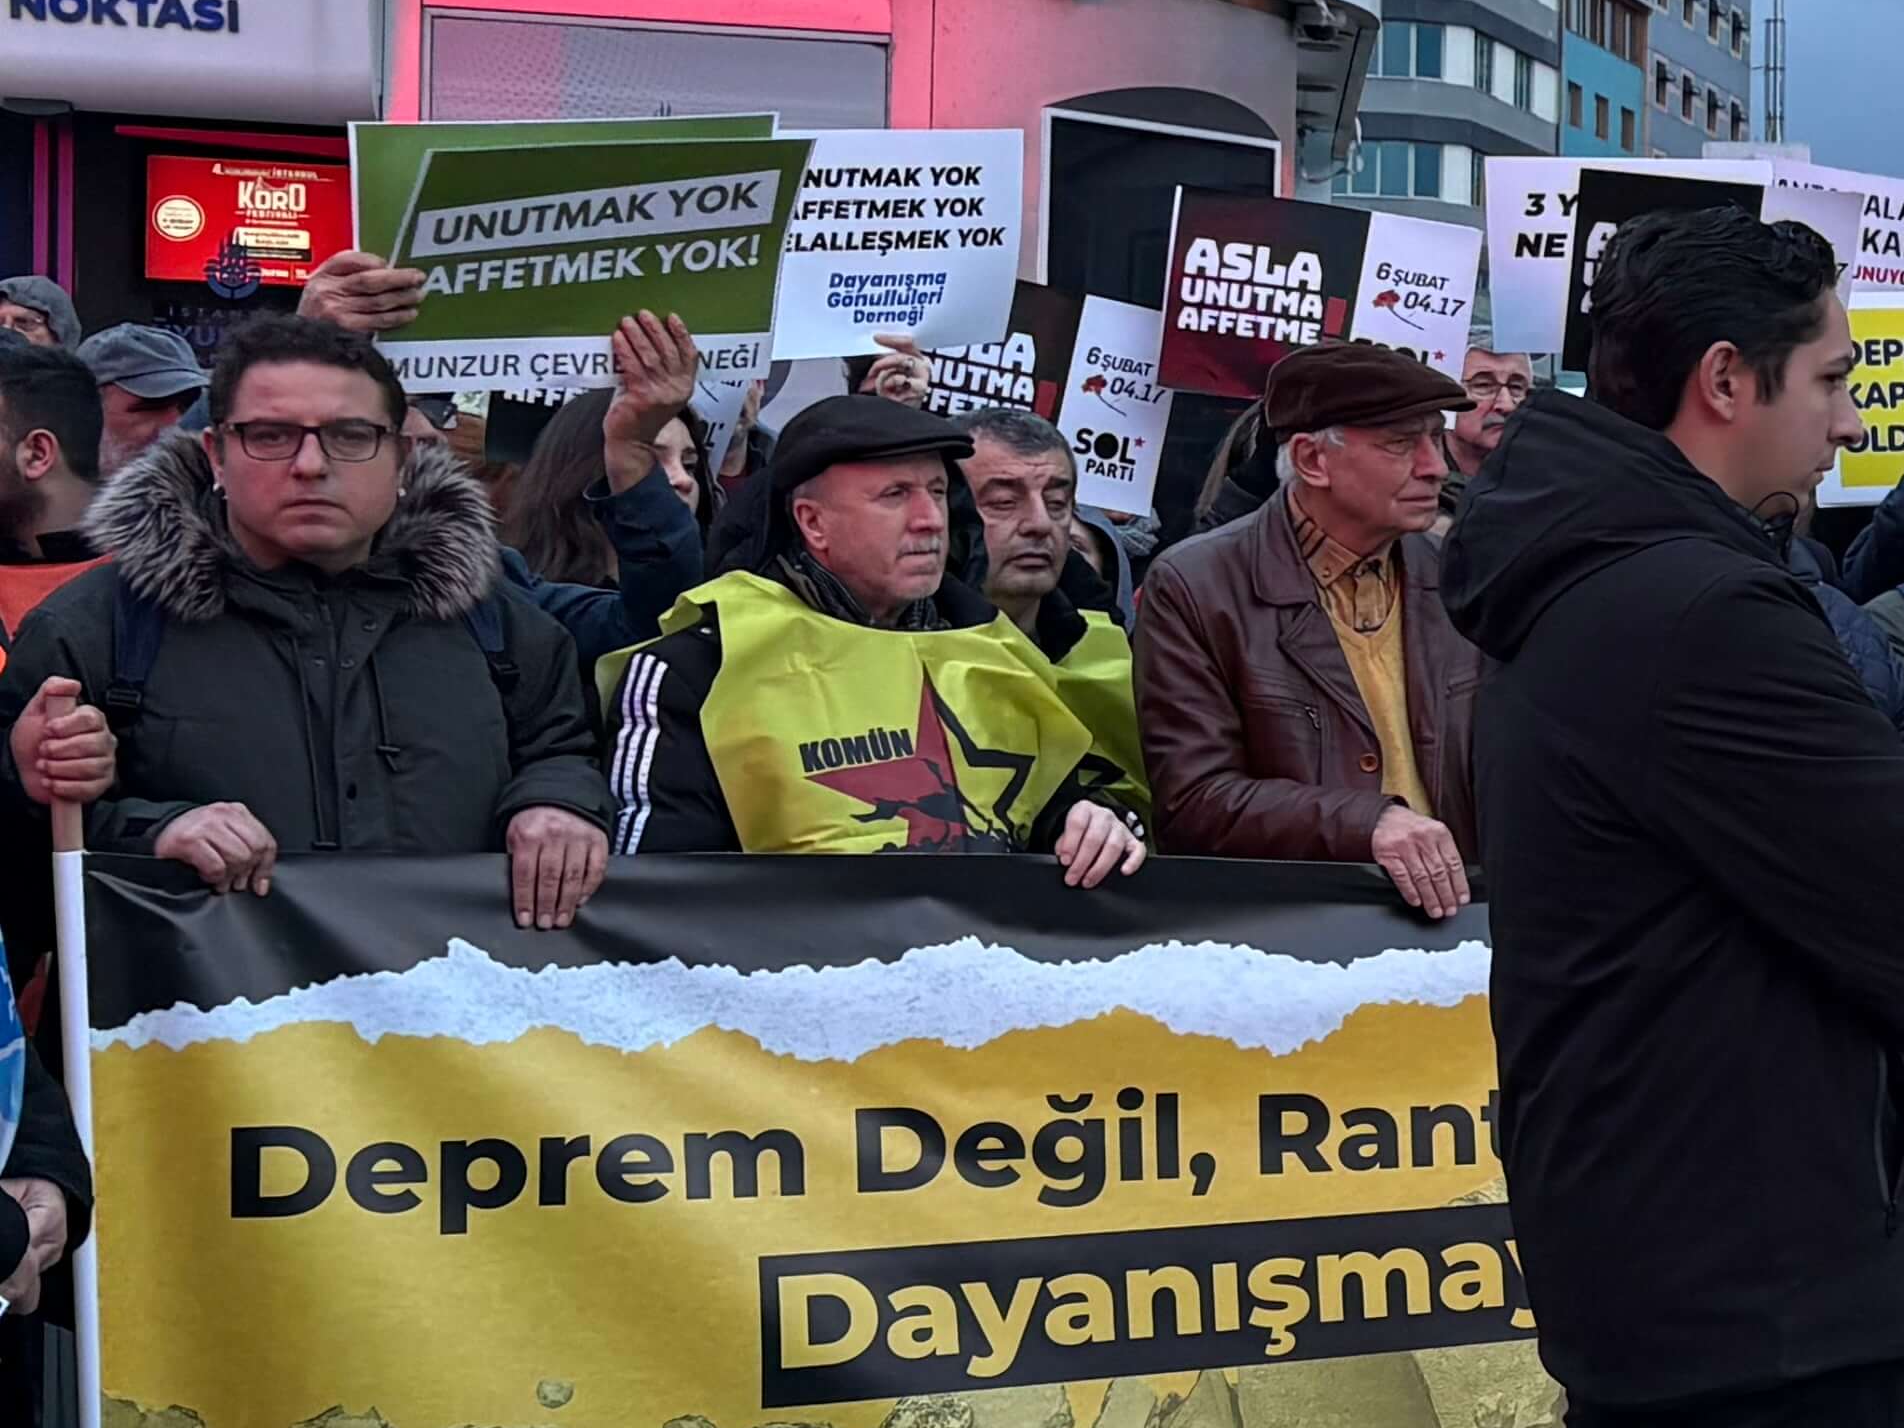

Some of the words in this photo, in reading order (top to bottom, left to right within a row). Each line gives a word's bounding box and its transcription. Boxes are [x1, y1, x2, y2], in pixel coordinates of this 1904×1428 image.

[802, 167, 923, 188] NUTMAK
[929, 166, 983, 187] YOK
[432, 190, 656, 246] UNUTMAK
[667, 180, 762, 217] YOK
[934, 197, 985, 217] YOK
[1525, 193, 1546, 217] 3
[958, 227, 1006, 248] YOK
[1515, 233, 1567, 258] NE
[424, 246, 645, 295] AFFETMEK
[655, 234, 761, 275] YOK!
[828, 272, 947, 292] Dayanışma
[1184, 237, 1323, 292] ASLA
[1375, 262, 1392, 282] 6
[1392, 267, 1450, 292] ŞUBAT
[1180, 276, 1322, 319] UNUTMA
[1403, 291, 1467, 318] 04.17
[1177, 304, 1322, 346] AFFETME
[1086, 347, 1101, 365] 6
[1101, 352, 1154, 379] ŞUBAT
[927, 360, 1035, 403] NUTMA
[1073, 428, 1137, 466] SOL
[798, 728, 913, 774] KOMÜN
[230, 1122, 806, 1236] Deprem
[855, 1086, 1216, 1209] Değil,
